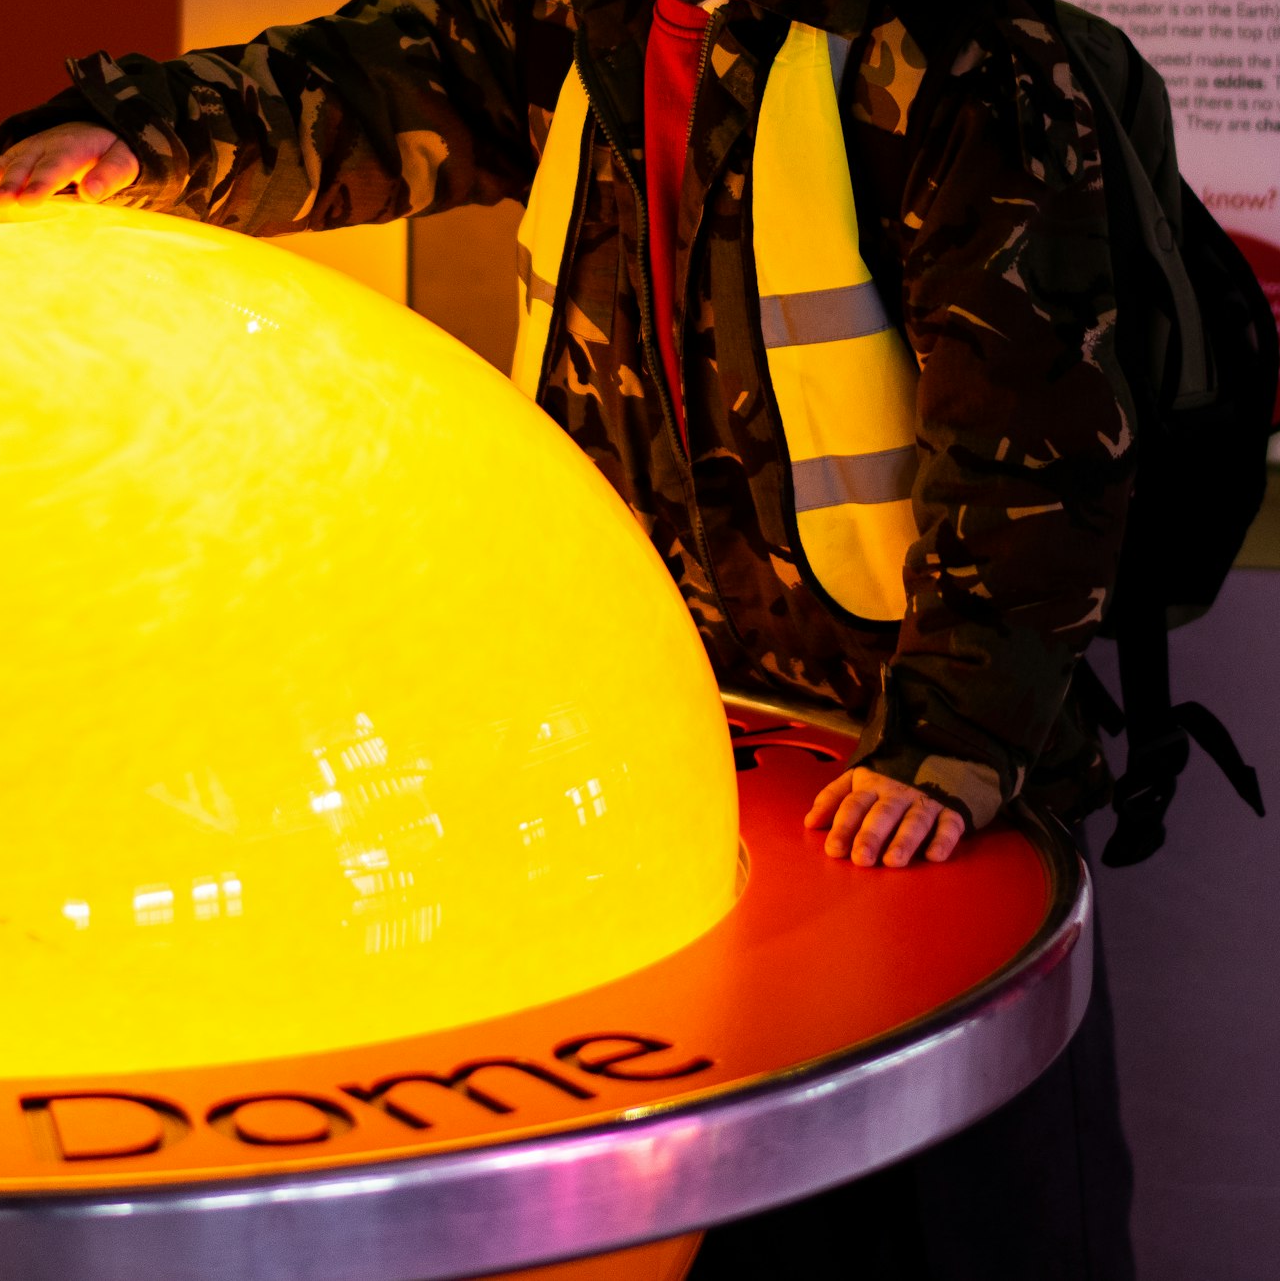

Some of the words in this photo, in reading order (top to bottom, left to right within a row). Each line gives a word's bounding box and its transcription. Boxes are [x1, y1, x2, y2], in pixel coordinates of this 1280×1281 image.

[1106, 2, 1163, 20] equator
[1169, 2, 1179, 17] is
[1183, 5, 1204, 18] on
[1207, 3, 1232, 18] the
[1129, 21, 1167, 40] liquid
[1171, 26, 1205, 39] near
[1209, 24, 1234, 39] the
[1237, 26, 1263, 43] top
[1196, 53, 1243, 69] makes
[1247, 53, 1271, 69] the
[1193, 77, 1209, 88] as
[1193, 95, 1233, 110] there
[1237, 97, 1249, 111] is
[1252, 99, 1273, 111] no
[1185, 113, 1222, 133] They
[1227, 119, 1251, 131] are
[1202, 185, 1278, 211] know?
[17, 1031, 716, 1164] Dome
